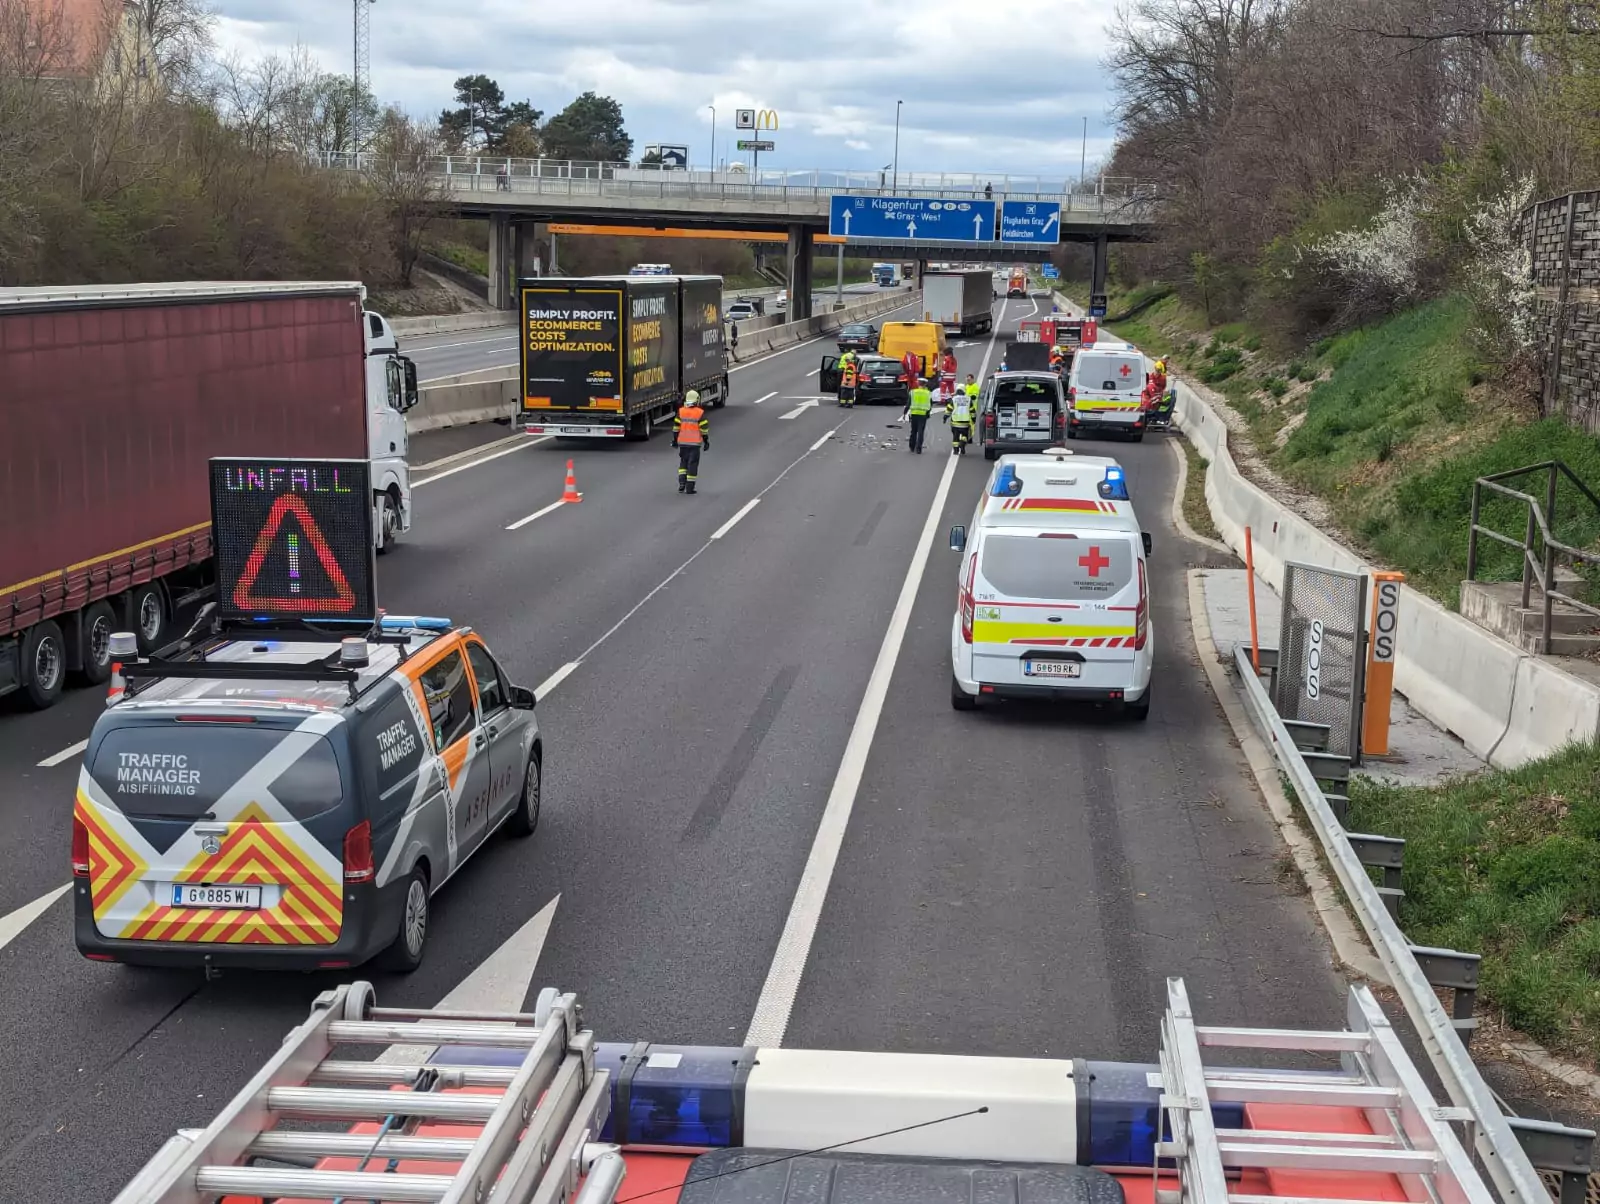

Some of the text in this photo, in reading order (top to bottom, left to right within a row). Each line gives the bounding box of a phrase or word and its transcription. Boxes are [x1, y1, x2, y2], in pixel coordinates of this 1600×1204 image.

[871, 199, 924, 211] Klagenfurt
[1003, 216, 1045, 226] Flughafen Graz
[529, 309, 617, 320] SIMPLY PROFIT.
[632, 298, 649, 318] SIMPLY
[529, 320, 602, 330] ECOMMERCE
[529, 331, 566, 340] COSTS
[529, 341, 616, 352] OPTIMIZATION.
[633, 345, 648, 366] COSTS
[226, 468, 351, 491] UNFALL
[1375, 584, 1397, 659] SOS
[1308, 620, 1322, 698] SOS
[376, 719, 407, 751] TRAFFIC
[118, 752, 188, 769] TRAFFIC
[380, 733, 417, 771] MANAGER
[117, 767, 200, 784] MANAGER
